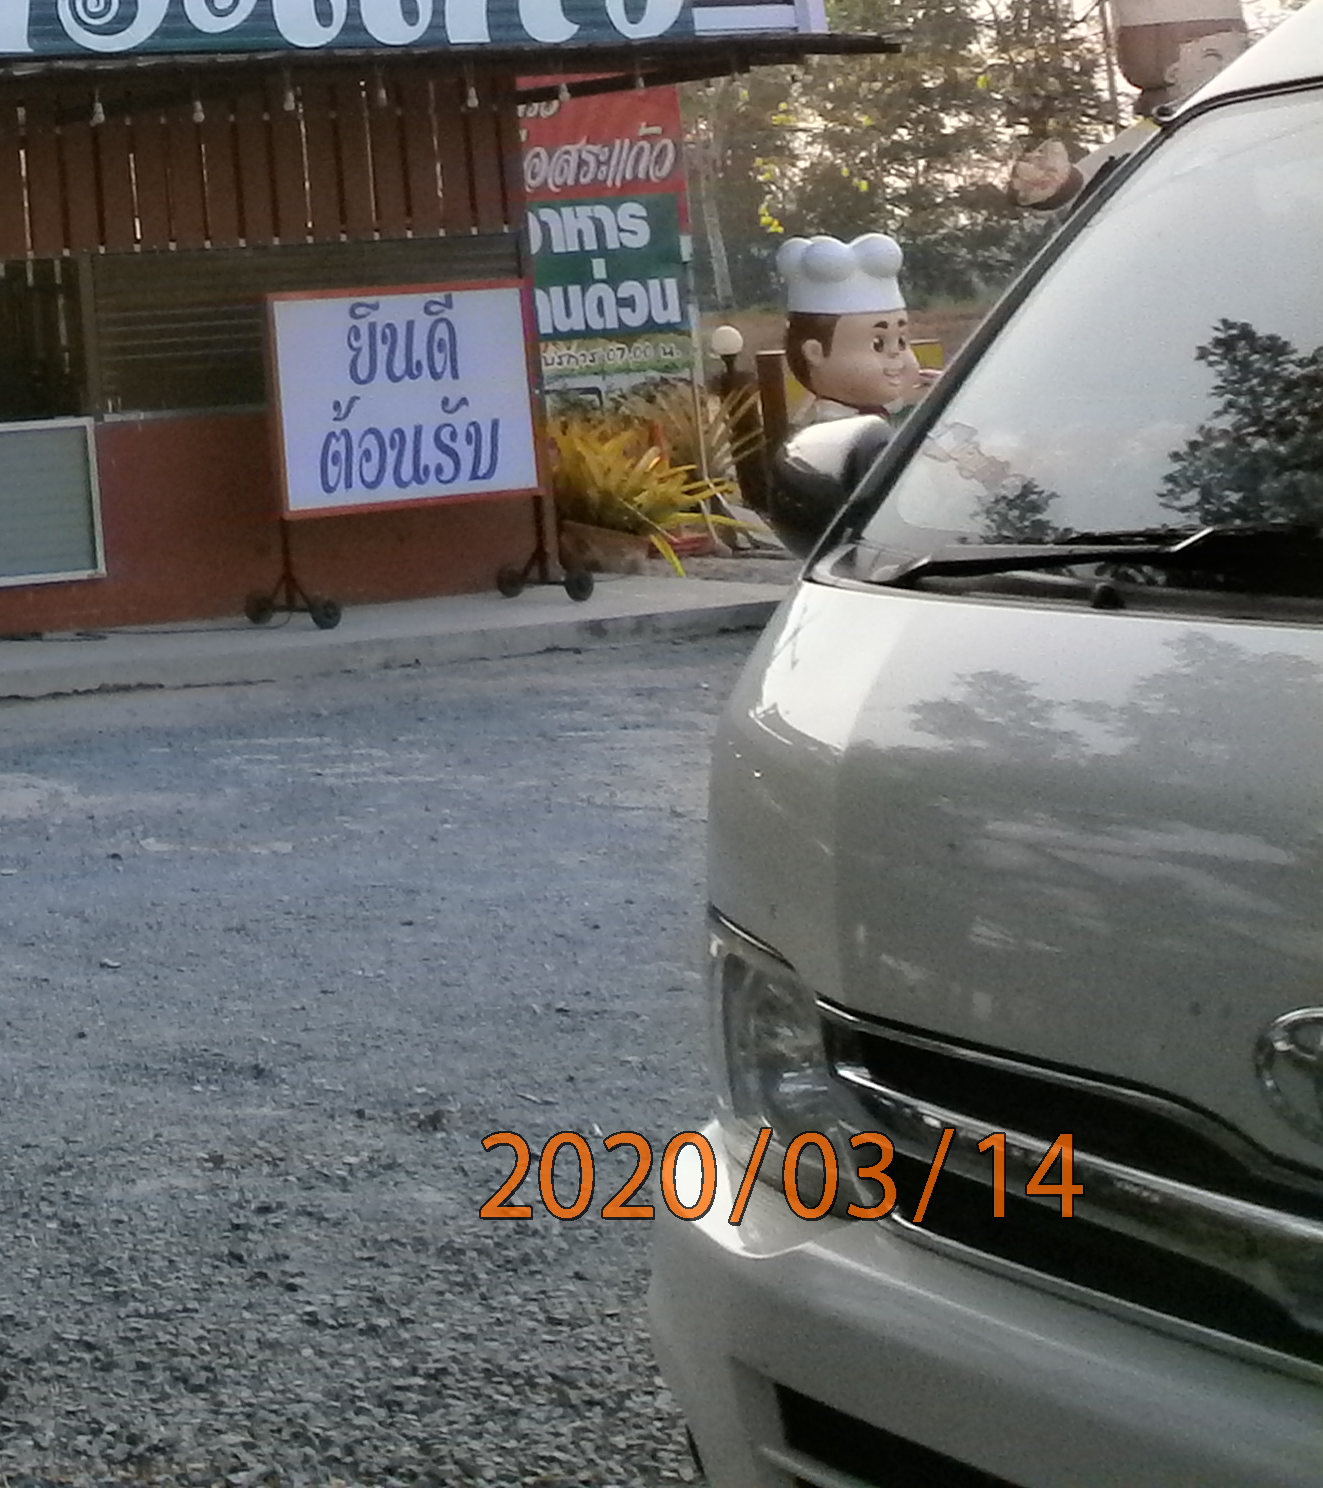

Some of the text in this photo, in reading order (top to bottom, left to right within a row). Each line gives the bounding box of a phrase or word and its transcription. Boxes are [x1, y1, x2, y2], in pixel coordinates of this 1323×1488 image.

[347, 293, 460, 386] ยินดี
[319, 395, 501, 495] ต้อนรับ
